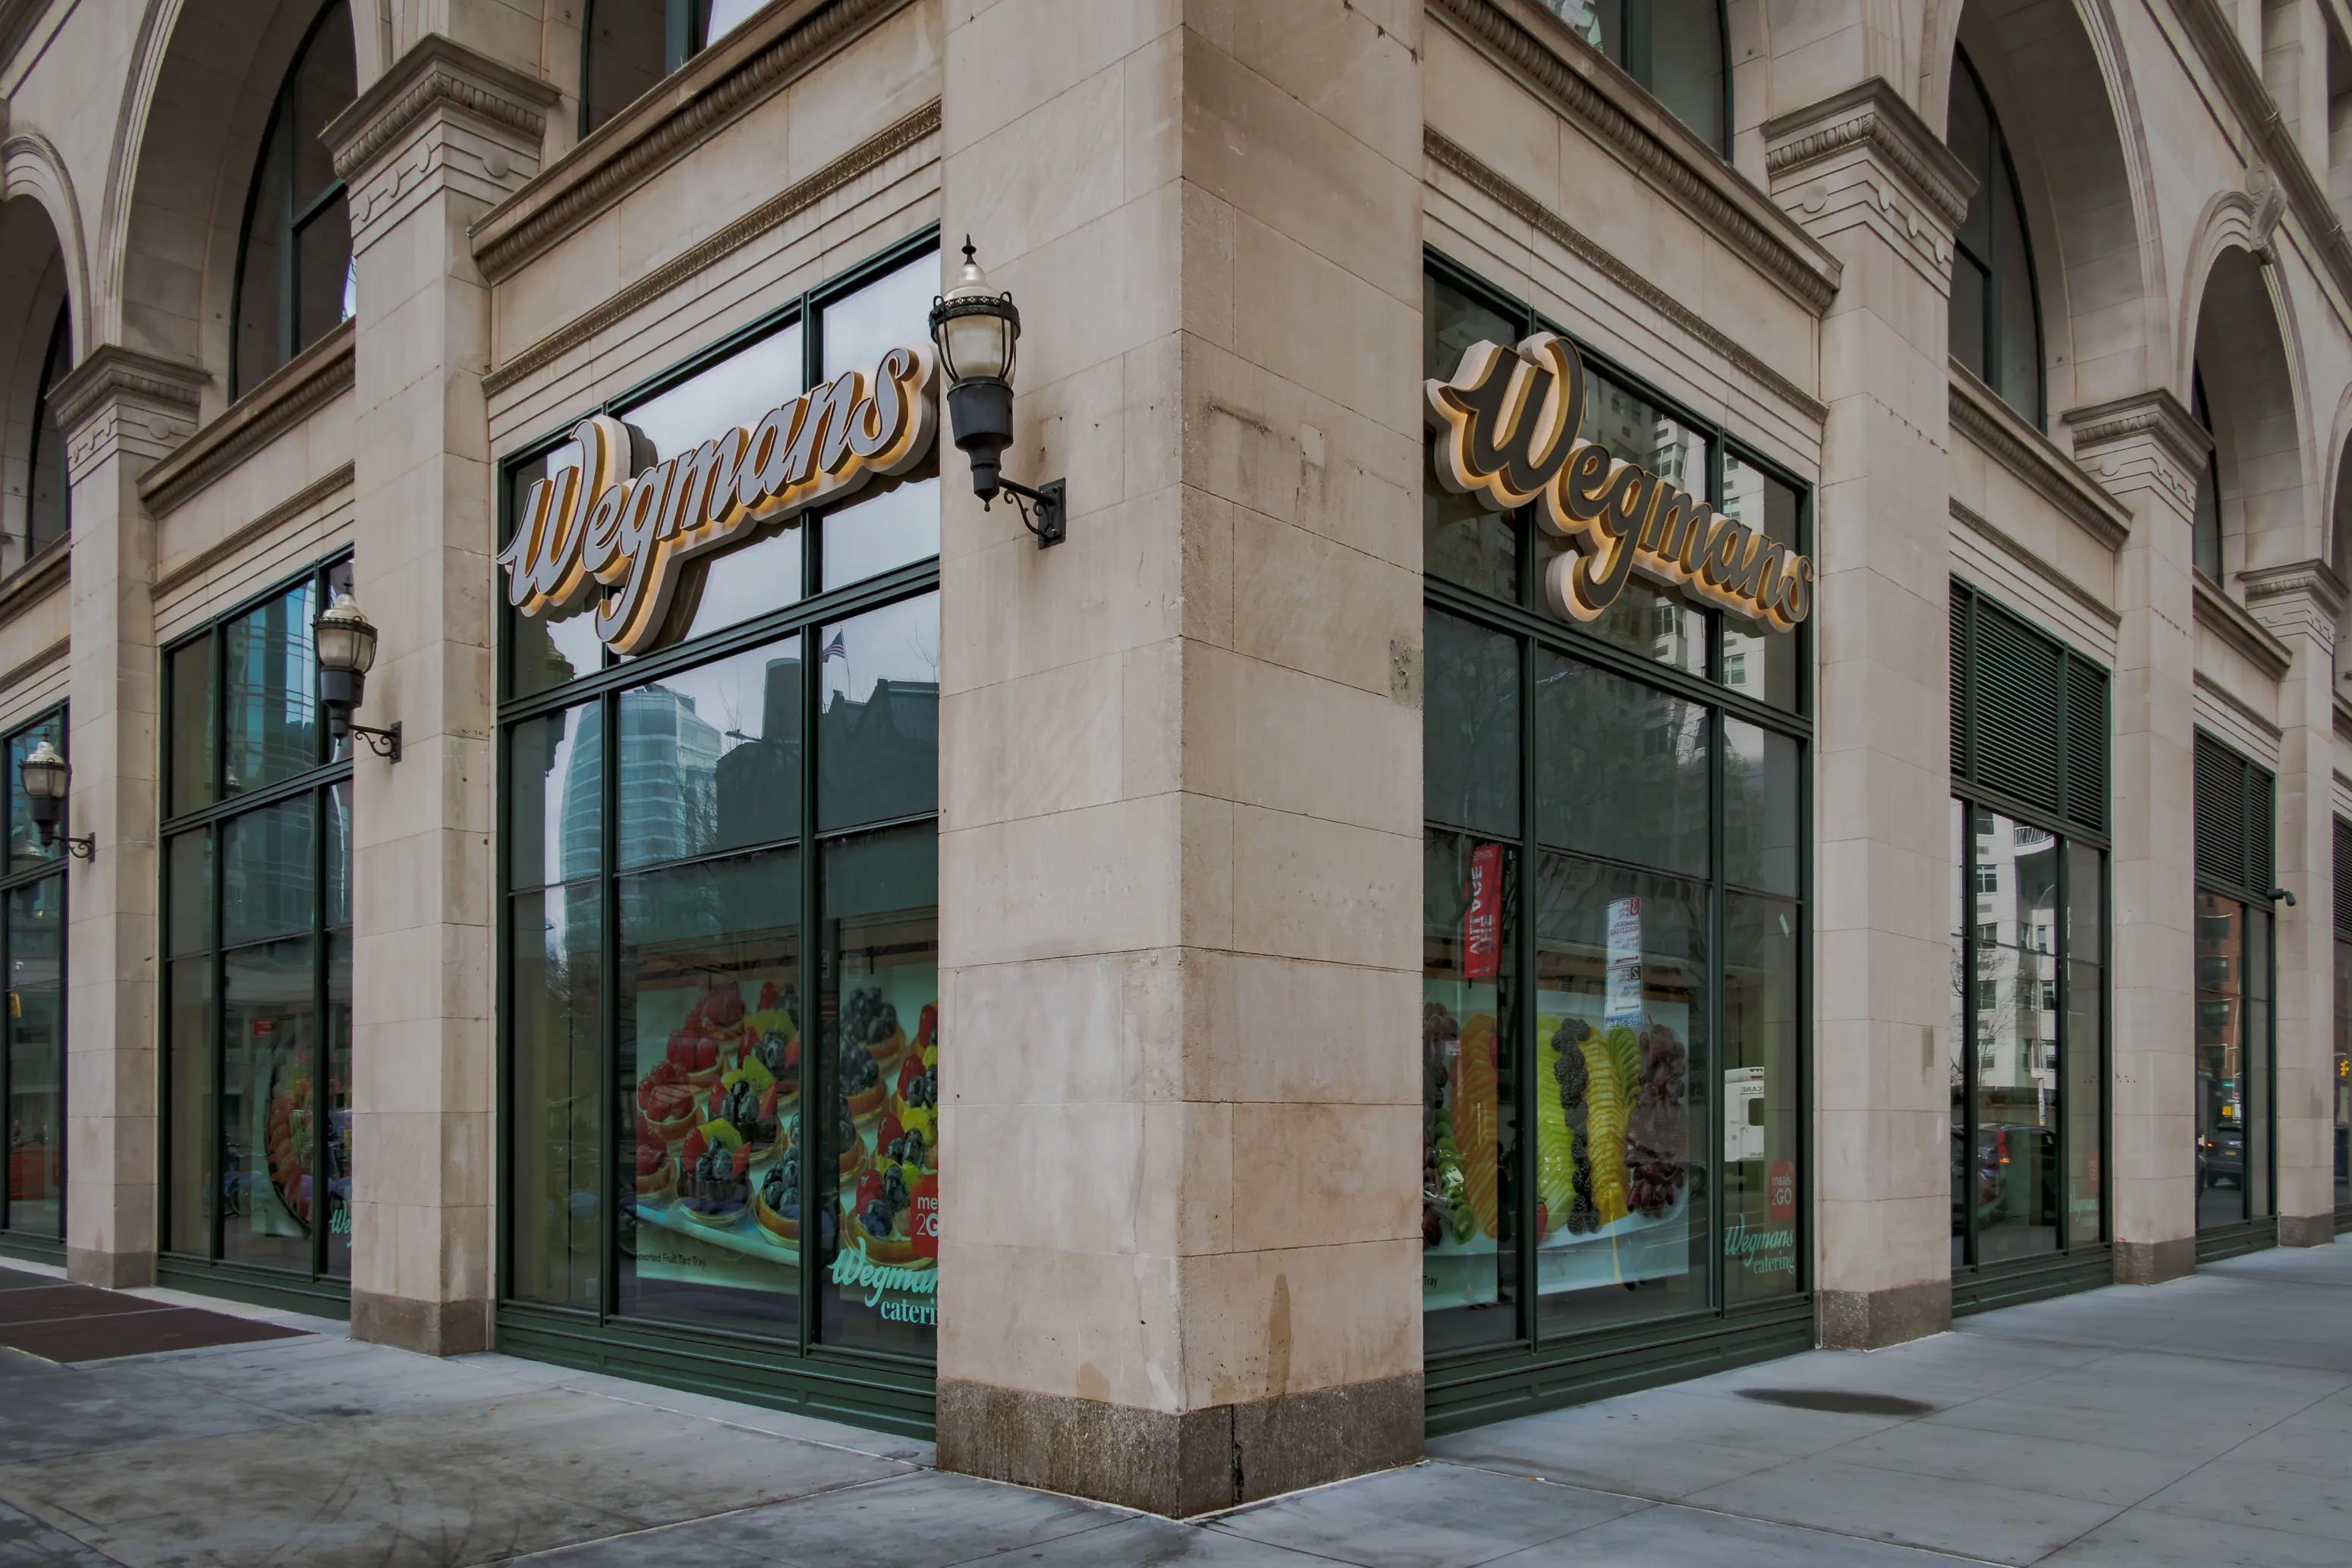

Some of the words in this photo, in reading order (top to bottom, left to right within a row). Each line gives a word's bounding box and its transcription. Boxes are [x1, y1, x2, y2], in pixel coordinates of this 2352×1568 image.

[1436, 335, 1814, 624] Wegmans
[496, 346, 924, 643] Wegmans
[1772, 1171, 1791, 1186] meals
[1771, 1187, 1792, 1206] 2GO
[916, 1212, 938, 1237] 2G
[1724, 1212, 1794, 1268] Wegmans
[662, 1253, 677, 1265] Fruit
[678, 1254, 690, 1265] Tart
[691, 1255, 706, 1270] Tray
[826, 1235, 938, 1308] Wegma
[1753, 1249, 1795, 1274] catering
[1423, 1274, 1439, 1289] Tray
[880, 1297, 939, 1326] cateri
